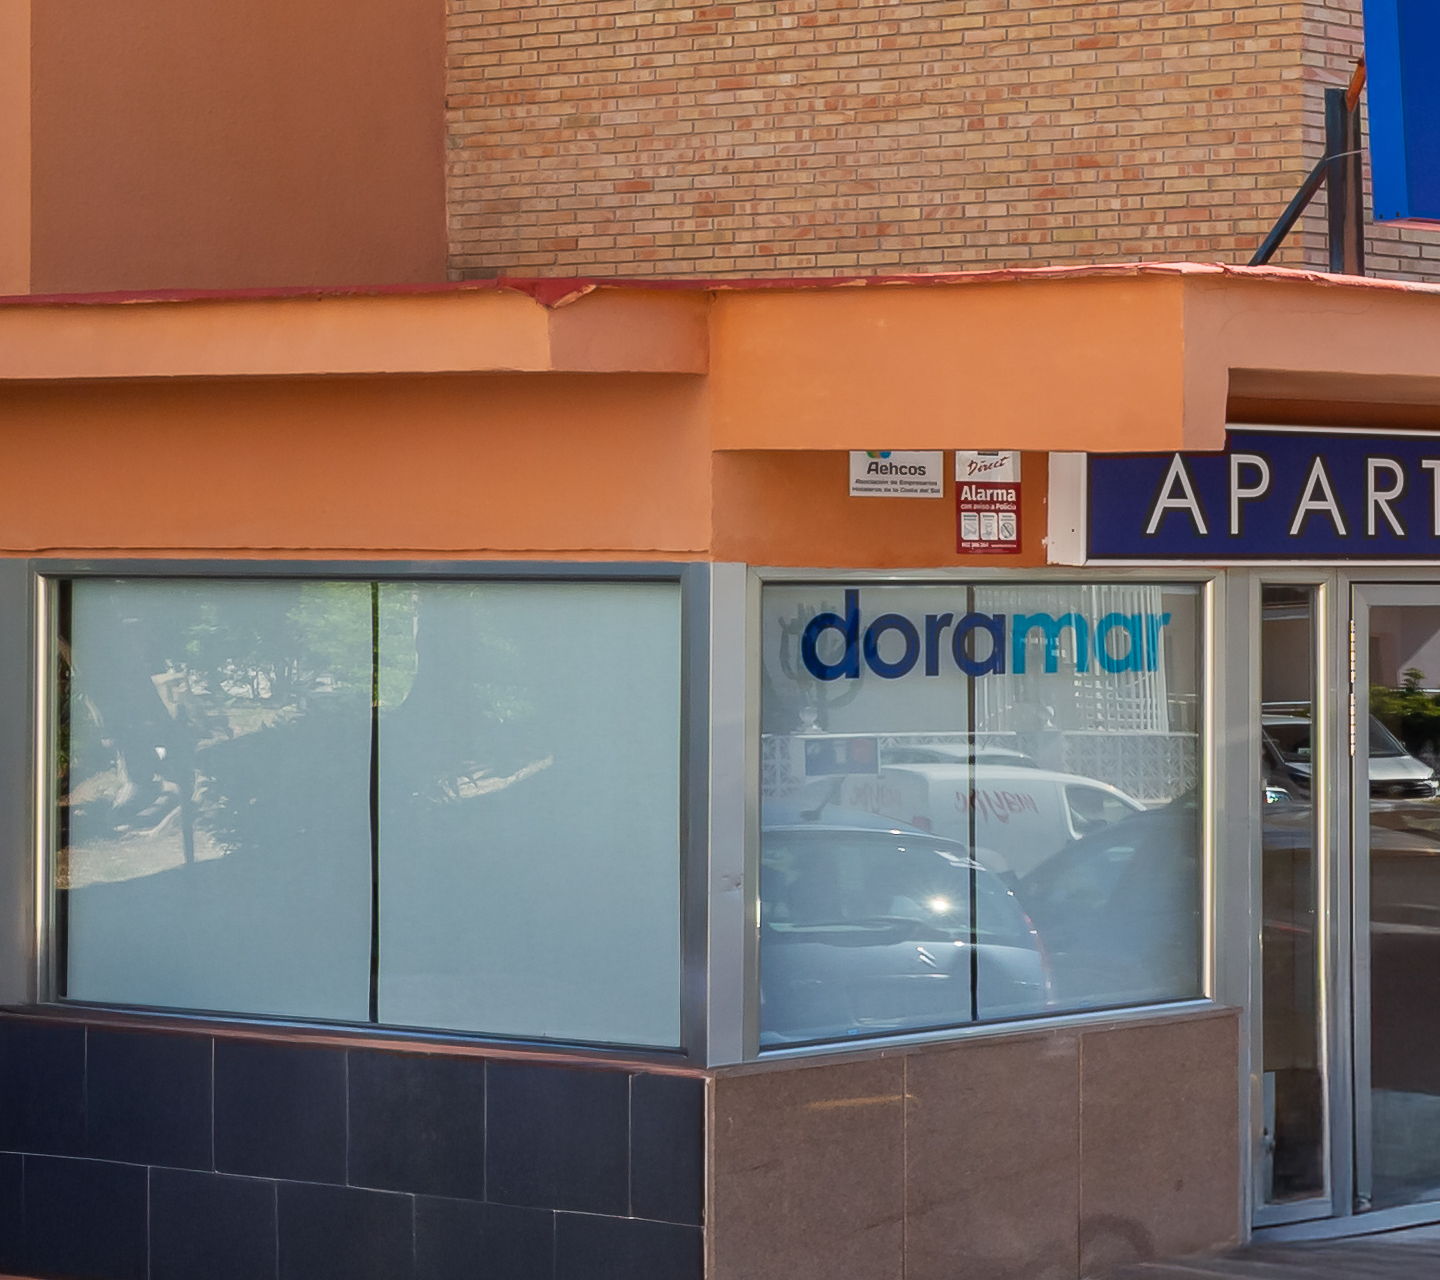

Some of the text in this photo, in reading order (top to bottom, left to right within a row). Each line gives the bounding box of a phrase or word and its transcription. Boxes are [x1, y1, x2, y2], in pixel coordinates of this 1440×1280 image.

[866, 461, 927, 477] Aehcos
[961, 484, 1017, 502] Alarma
[801, 588, 1172, 682] doramar
